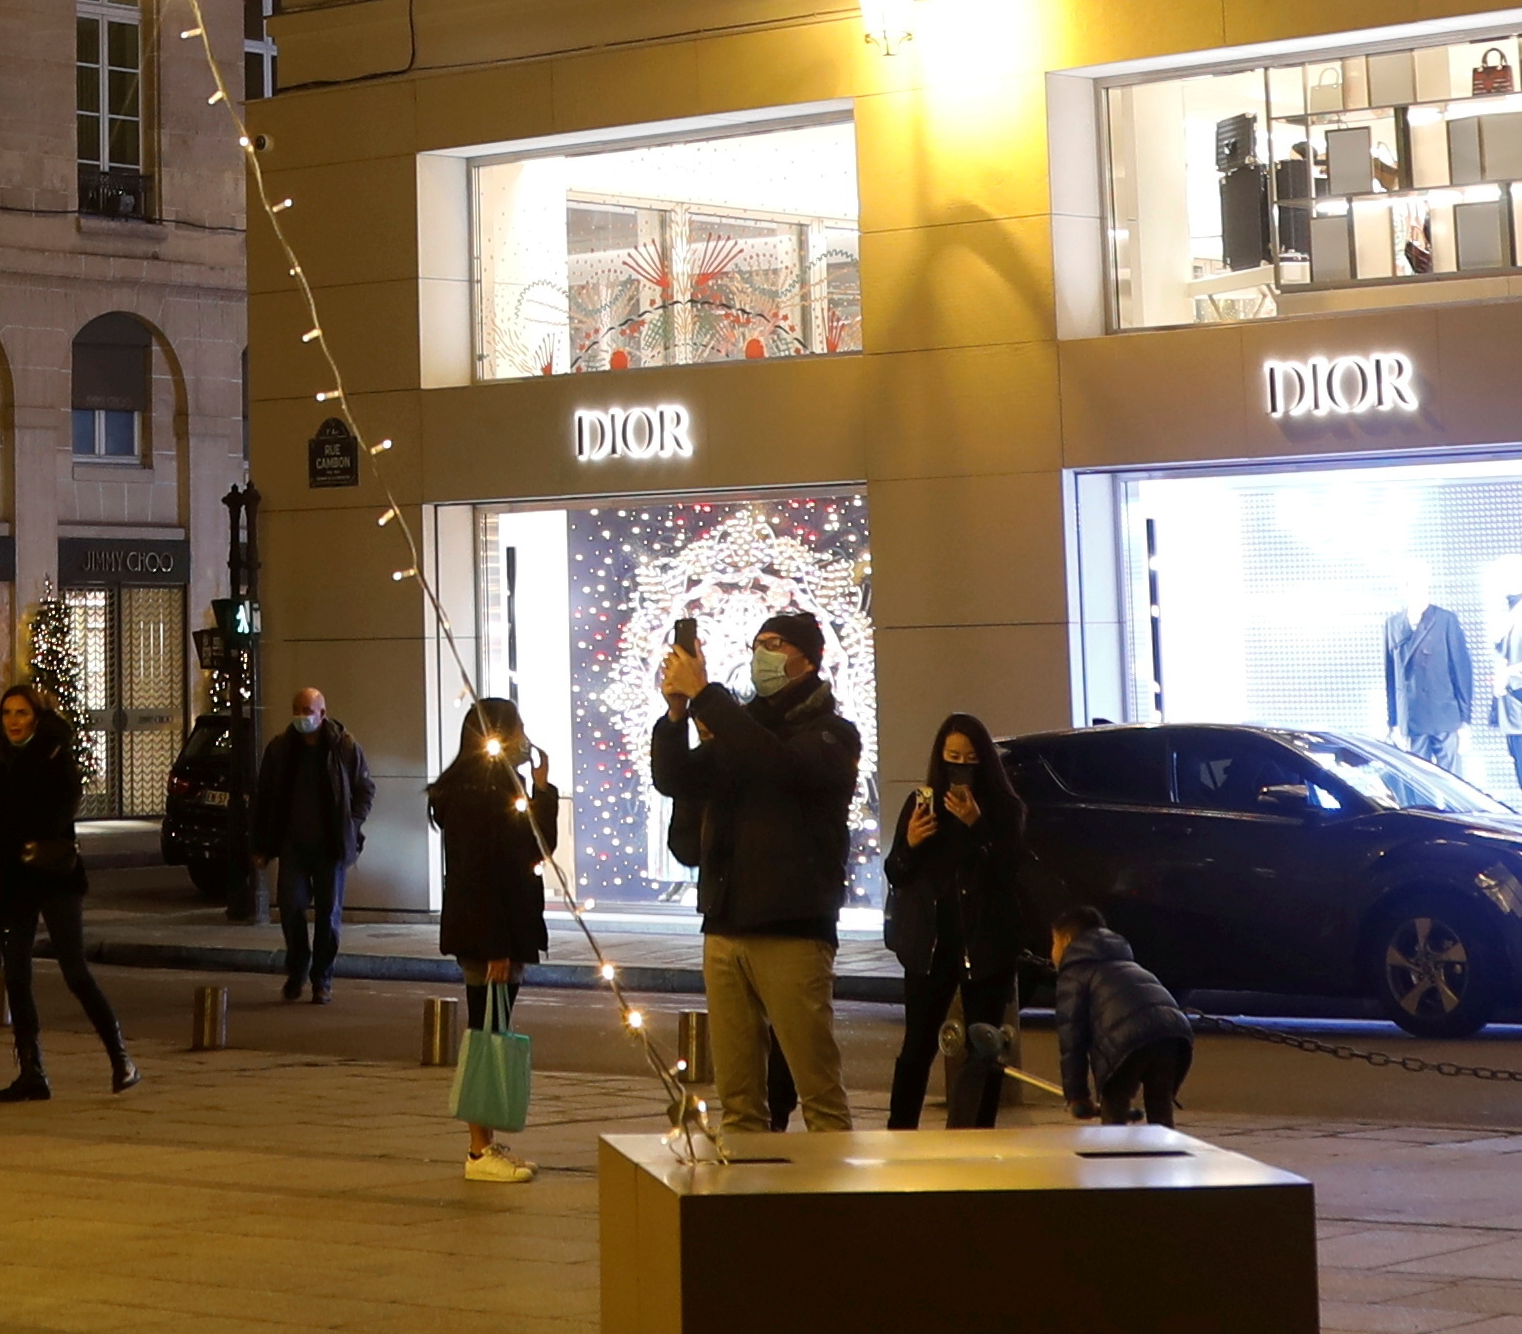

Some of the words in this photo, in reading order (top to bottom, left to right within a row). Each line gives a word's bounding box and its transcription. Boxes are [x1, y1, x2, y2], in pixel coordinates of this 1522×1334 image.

[1264, 353, 1418, 417] DIOR
[324, 443, 341, 455] RUE
[575, 406, 693, 460] DIOR
[83, 551, 124, 572] JIMMY
[127, 551, 174, 572] CHOO
